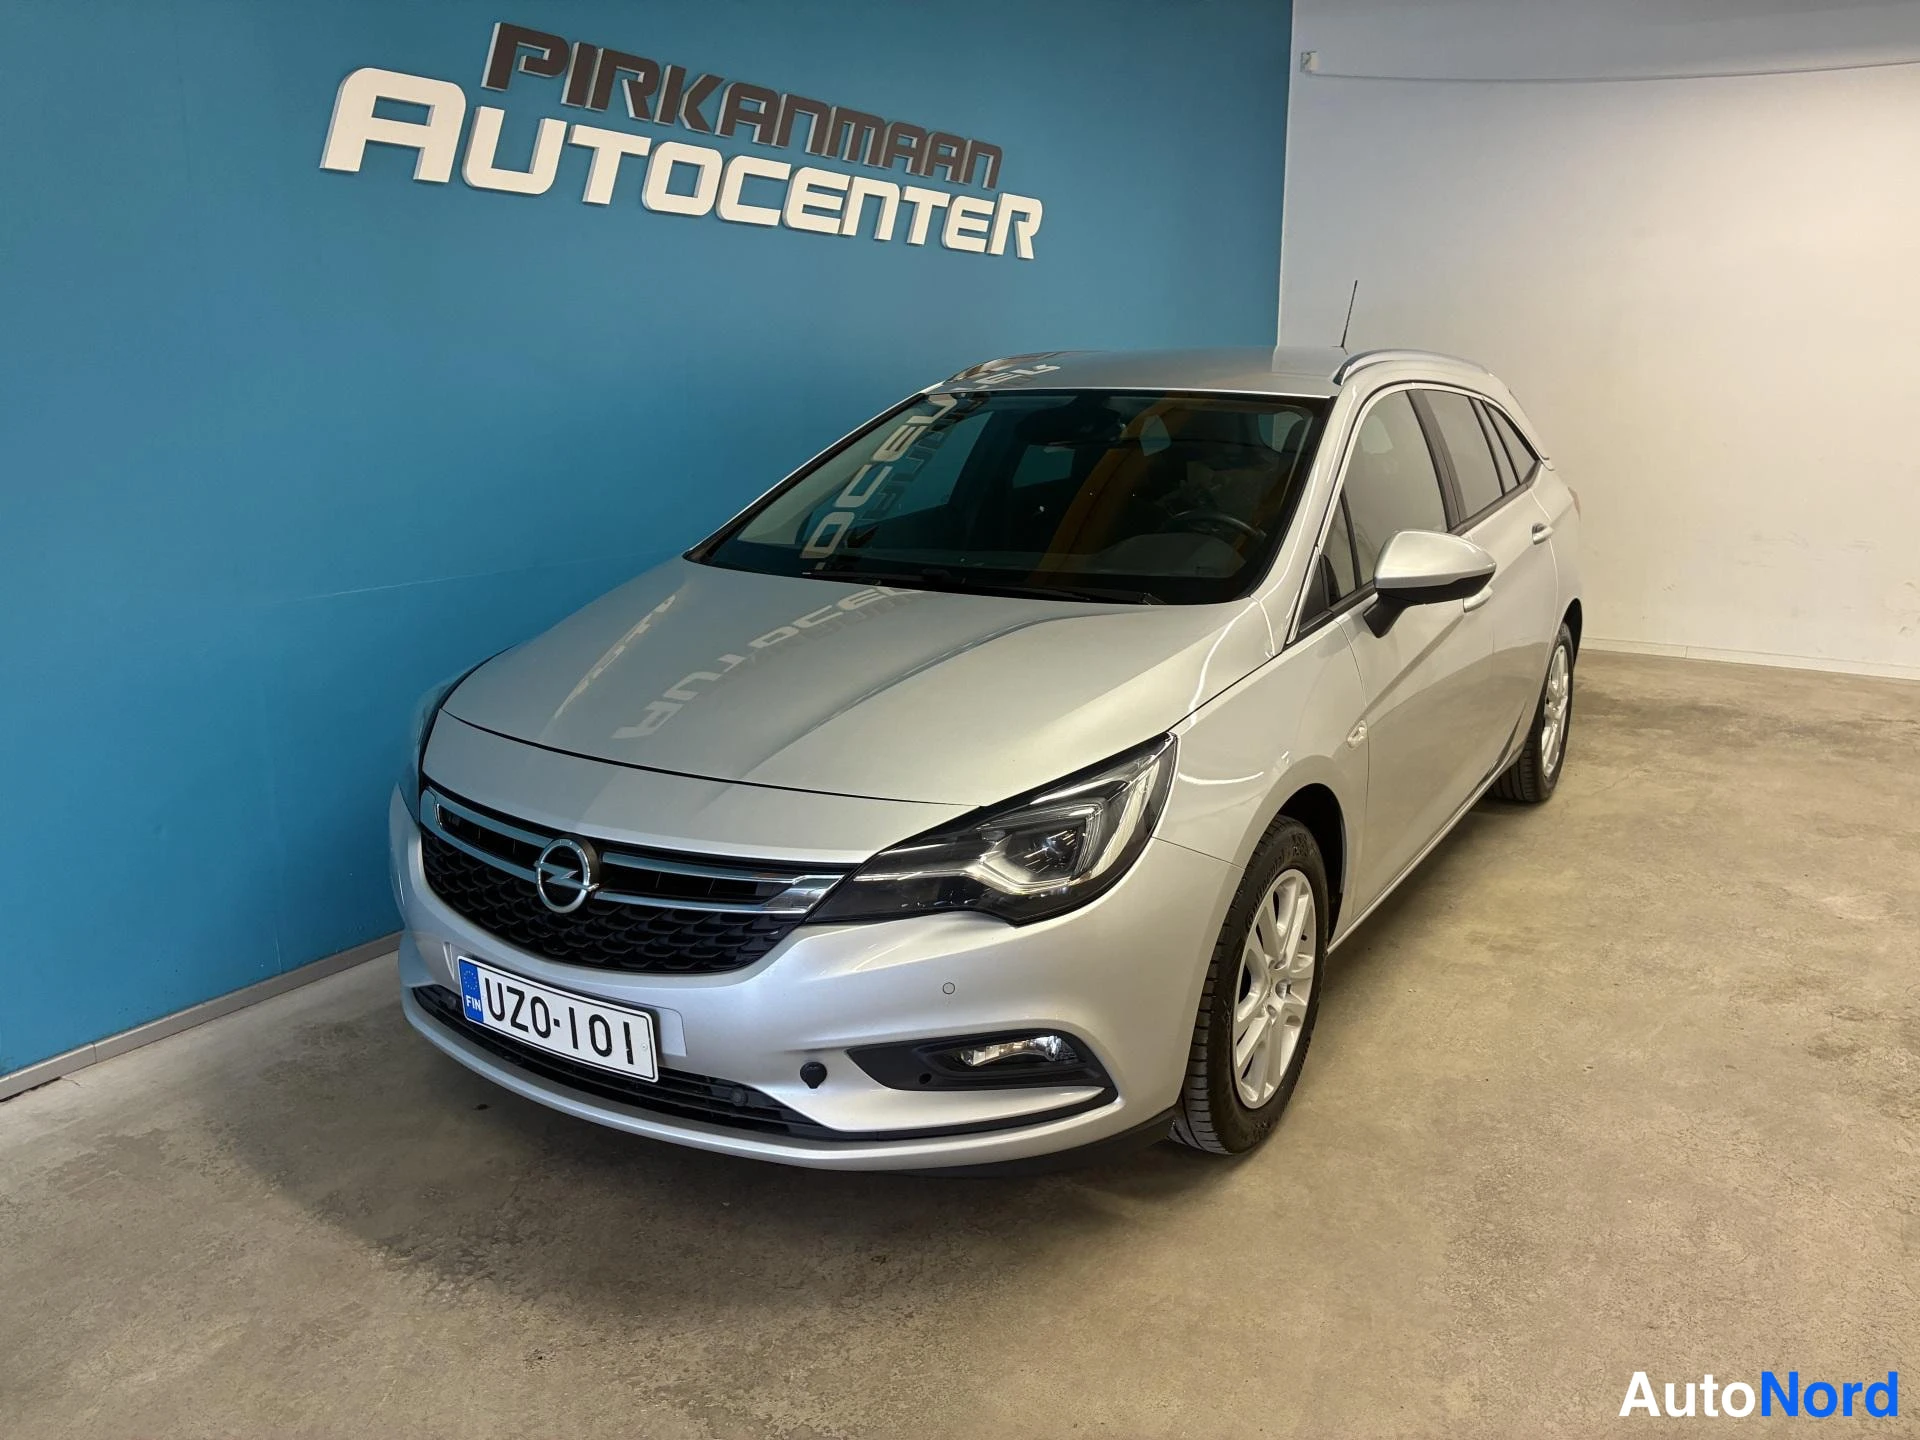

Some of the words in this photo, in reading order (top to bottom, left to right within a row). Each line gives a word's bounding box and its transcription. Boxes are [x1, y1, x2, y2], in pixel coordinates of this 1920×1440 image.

[319, 67, 1043, 260] AUTOCENTER
[481, 22, 1003, 189] PIRKANMAAN
[465, 995, 482, 1012] FIN
[484, 977, 634, 1065] UZO-101
